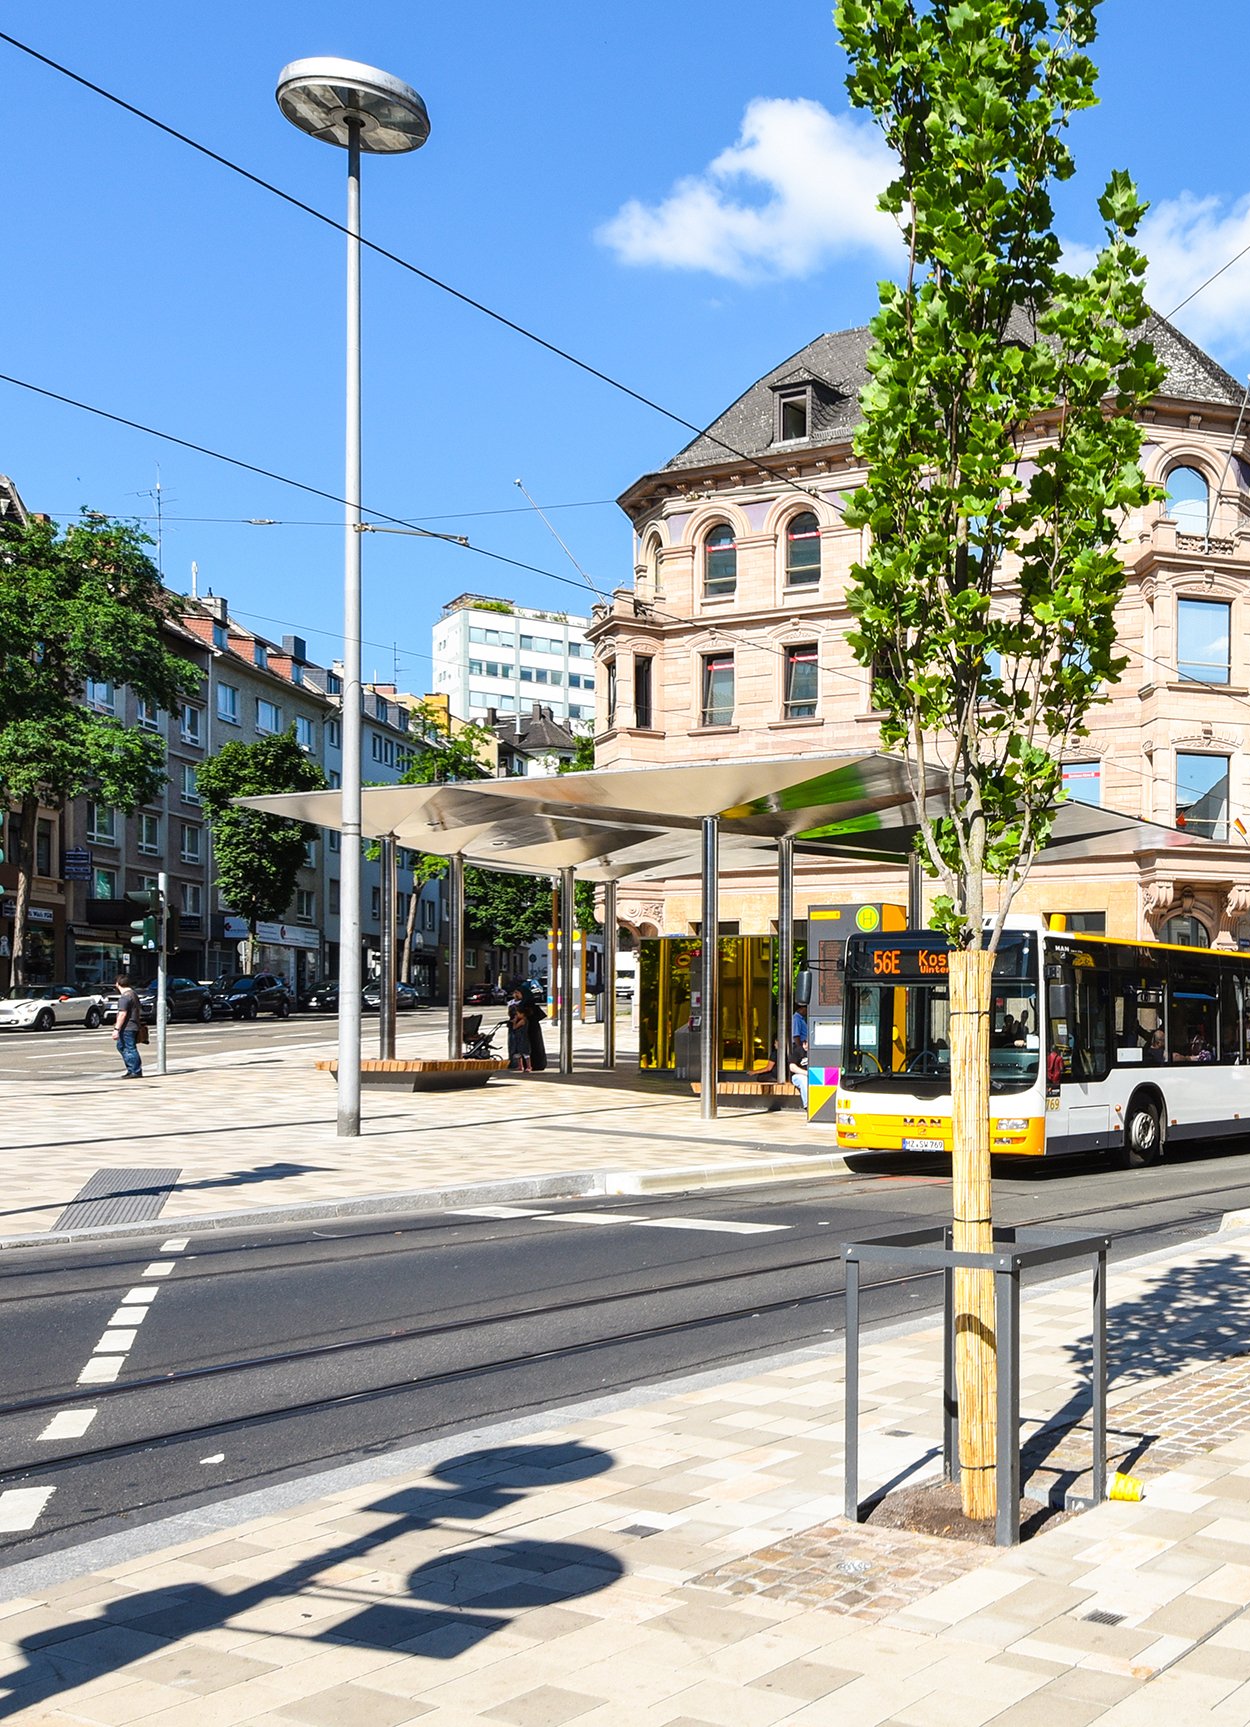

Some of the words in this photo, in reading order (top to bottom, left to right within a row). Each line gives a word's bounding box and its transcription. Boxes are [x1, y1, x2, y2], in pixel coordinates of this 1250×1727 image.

[873, 950, 901, 974] 56E
[918, 949, 948, 966] Kos
[1045, 1098, 1060, 1110] 769
[903, 1117, 942, 1126] MAN
[919, 1140, 928, 1148] SW
[930, 1140, 943, 1148] 769
